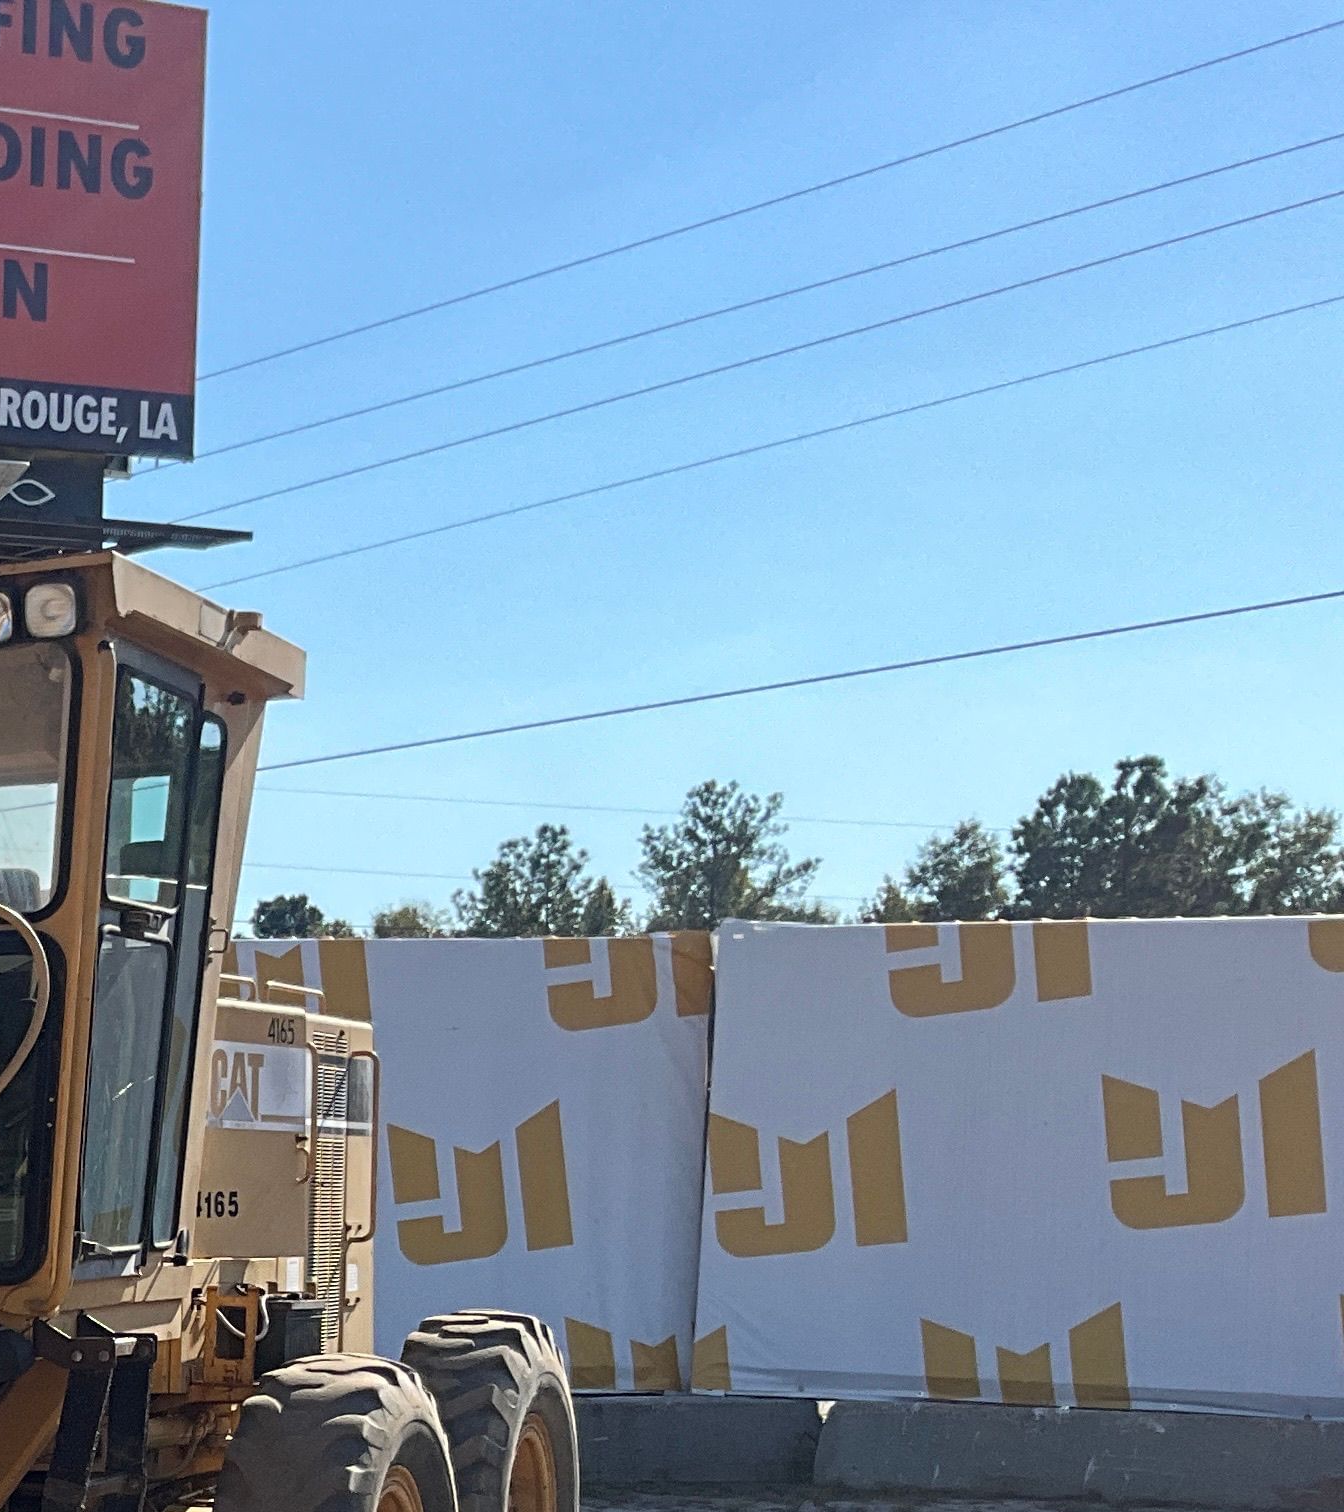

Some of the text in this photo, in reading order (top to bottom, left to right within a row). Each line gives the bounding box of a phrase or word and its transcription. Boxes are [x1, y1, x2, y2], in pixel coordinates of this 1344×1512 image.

[0, 396, 128, 442] ROUGE,
[140, 401, 177, 440] LA
[267, 1017, 295, 1044] 4165
[211, 1048, 265, 1121] CAT
